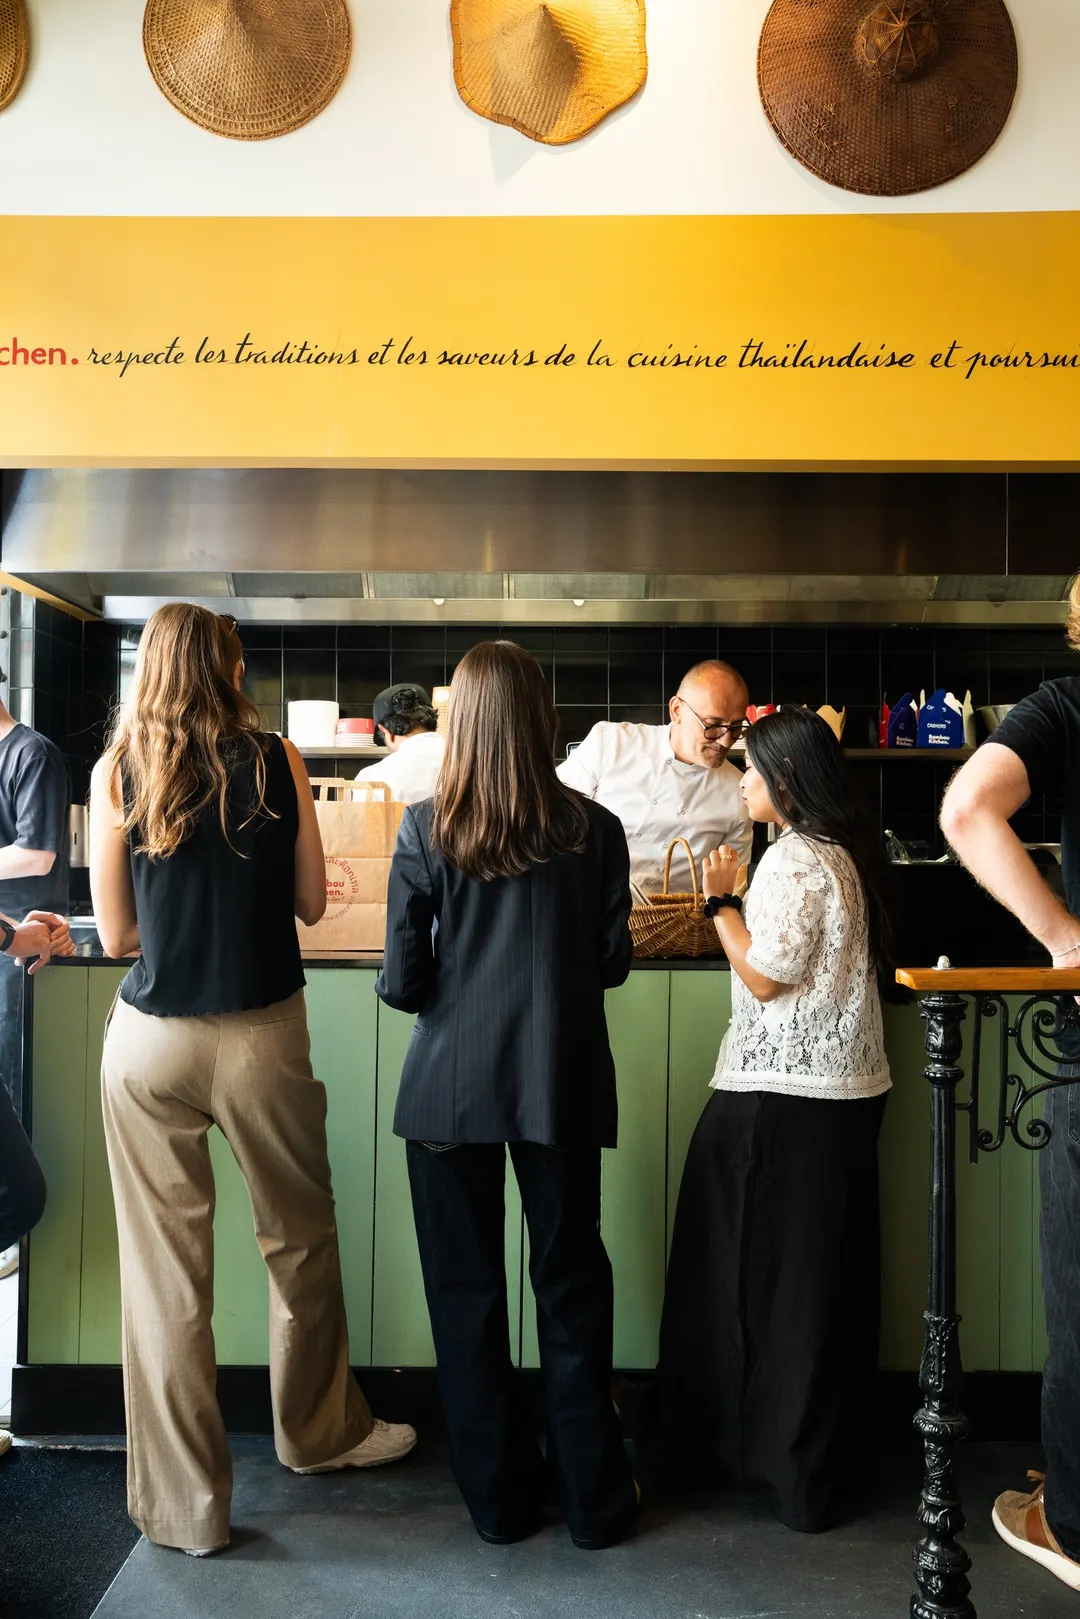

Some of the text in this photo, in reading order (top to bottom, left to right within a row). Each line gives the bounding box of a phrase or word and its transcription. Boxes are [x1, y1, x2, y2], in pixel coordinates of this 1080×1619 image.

[86, 336, 184, 378] respecte
[194, 336, 226, 365] les
[234, 332, 359, 365] traditions
[367, 337, 394, 365] et
[397, 336, 429, 365] les
[436, 348, 539, 366] saveurs
[544, 343, 577, 367] de
[586, 339, 618, 367] la
[627, 343, 728, 368] cuisine
[738, 338, 915, 369] thaïlandaise
[929, 340, 963, 369] et
[326, 879, 345, 888] bou
